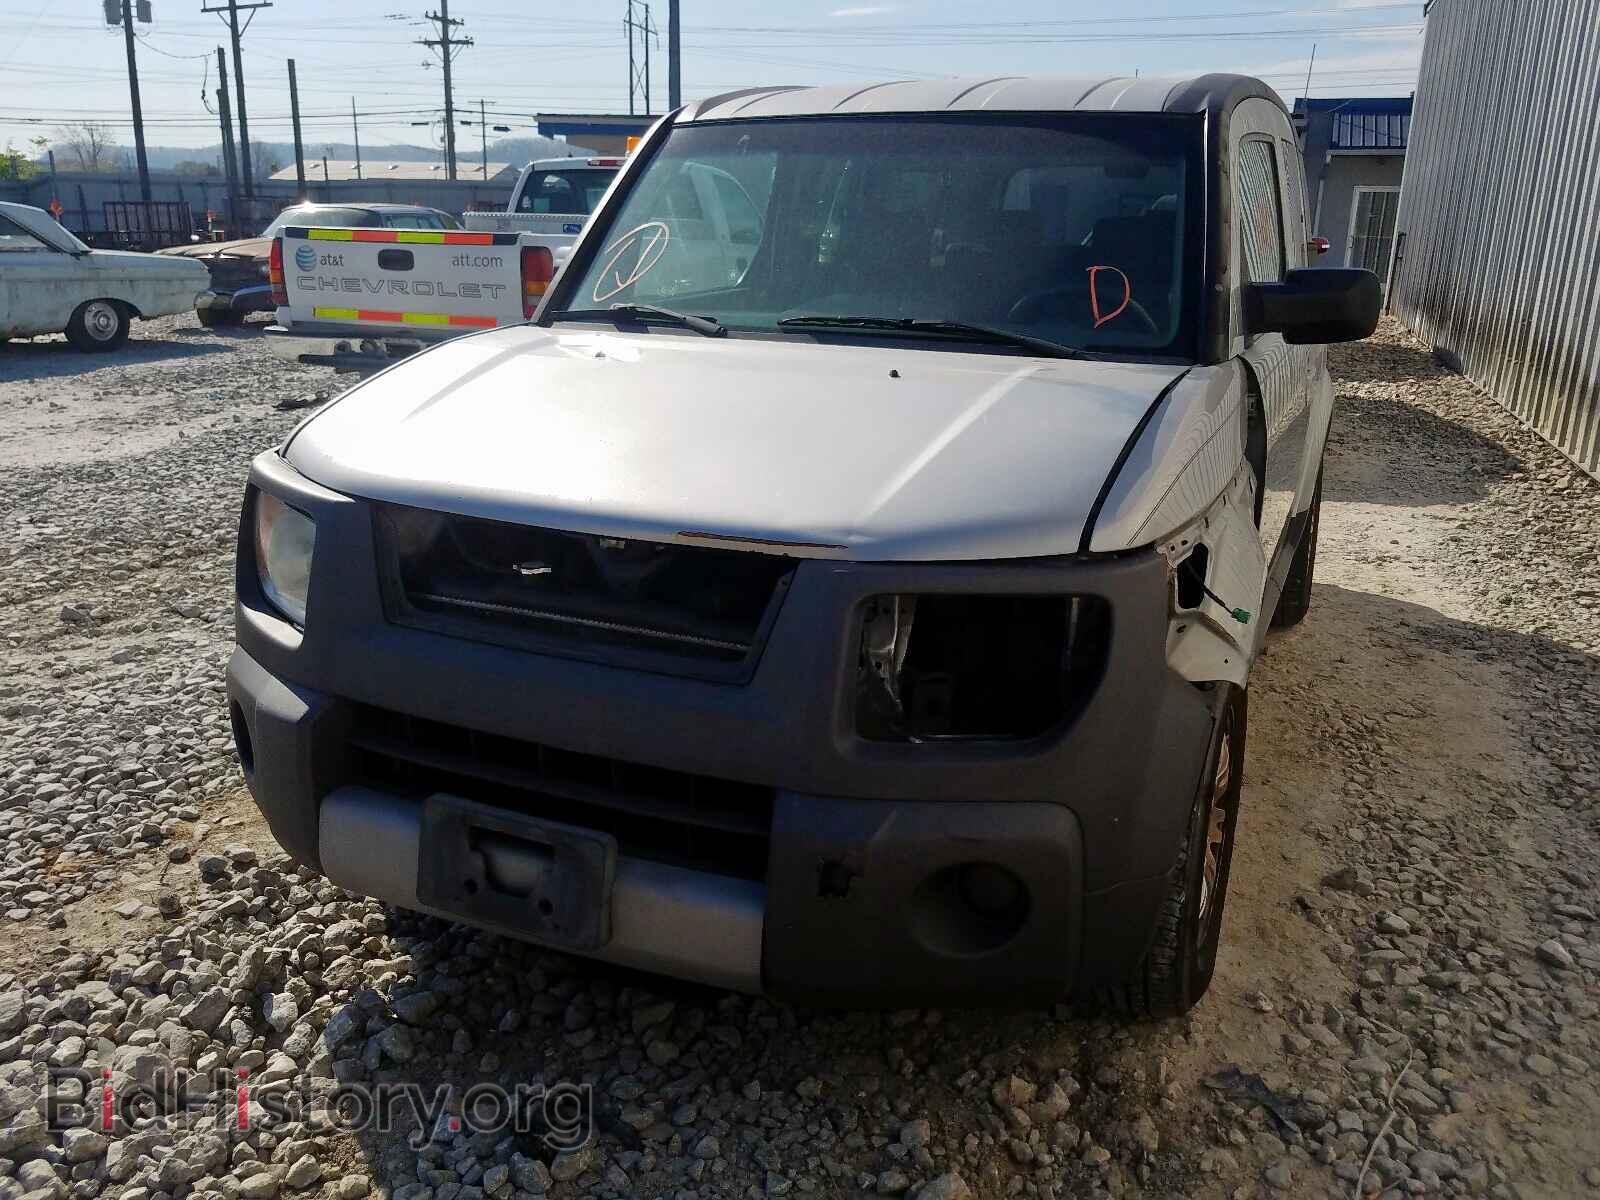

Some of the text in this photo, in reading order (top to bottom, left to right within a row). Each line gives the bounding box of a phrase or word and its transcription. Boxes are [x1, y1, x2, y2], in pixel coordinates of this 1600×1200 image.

[320, 254, 344, 267] at&t
[452, 253, 503, 268] att.com
[296, 276, 506, 300] CHEVROLET
[1086, 265, 1131, 328] D
